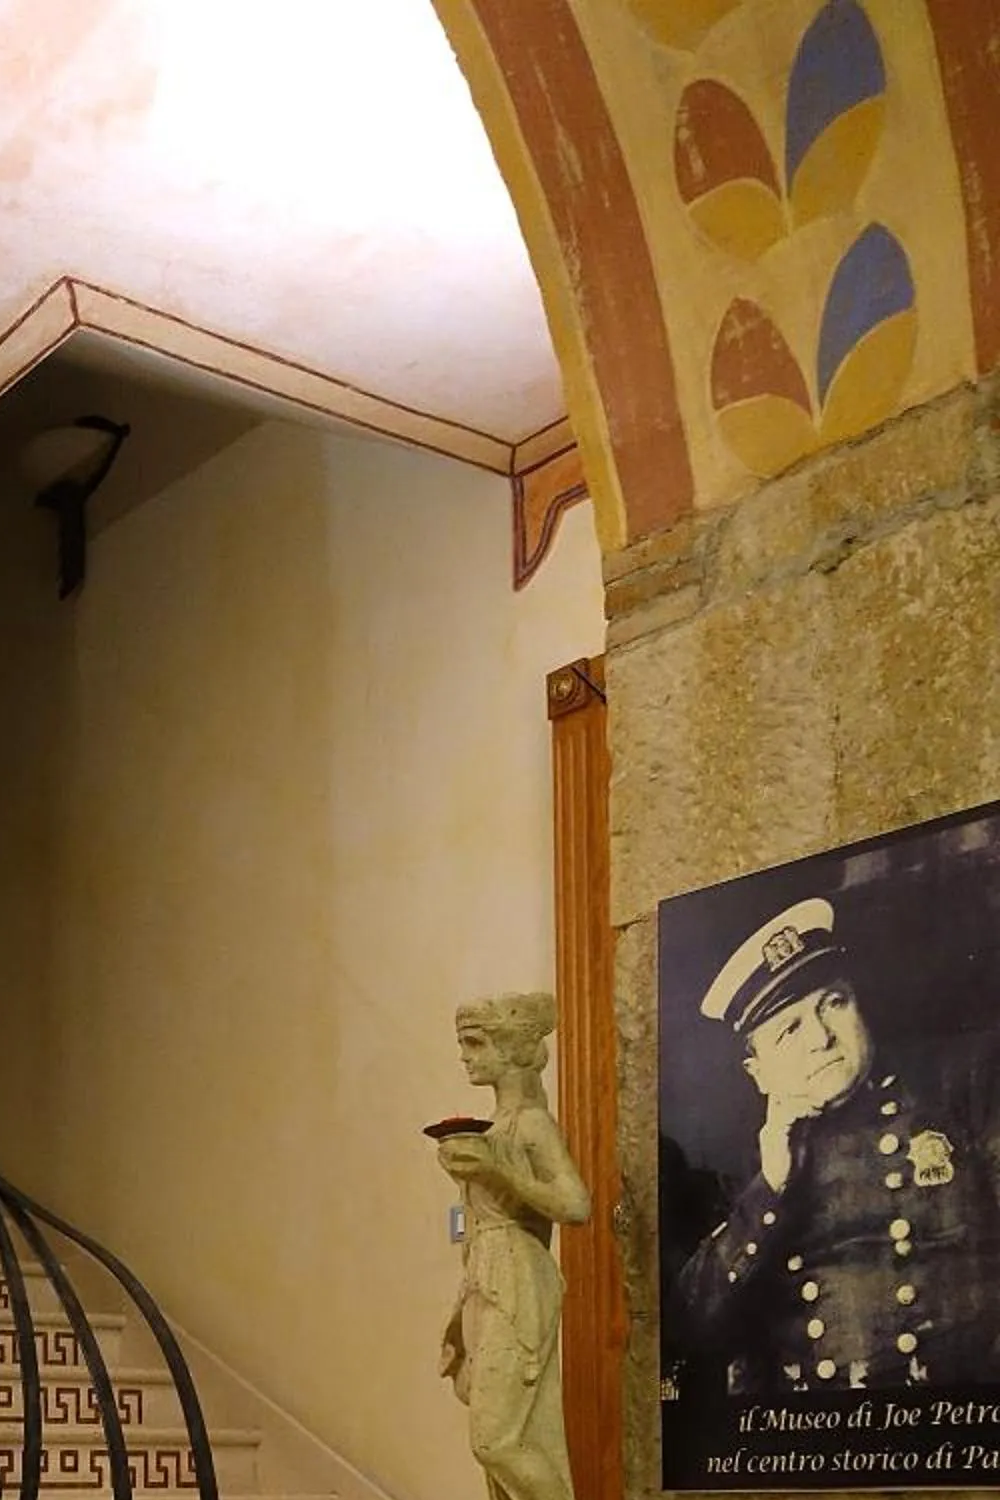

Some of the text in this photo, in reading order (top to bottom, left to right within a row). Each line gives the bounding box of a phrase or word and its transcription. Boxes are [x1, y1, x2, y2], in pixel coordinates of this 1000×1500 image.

[739, 1405, 758, 1433] il
[759, 1408, 841, 1432] Museo
[847, 1401, 872, 1428] di
[876, 1402, 922, 1430] Joe
[706, 1448, 746, 1474] nel
[747, 1447, 825, 1472] centro
[831, 1445, 919, 1471] storico
[926, 1441, 954, 1469] di
